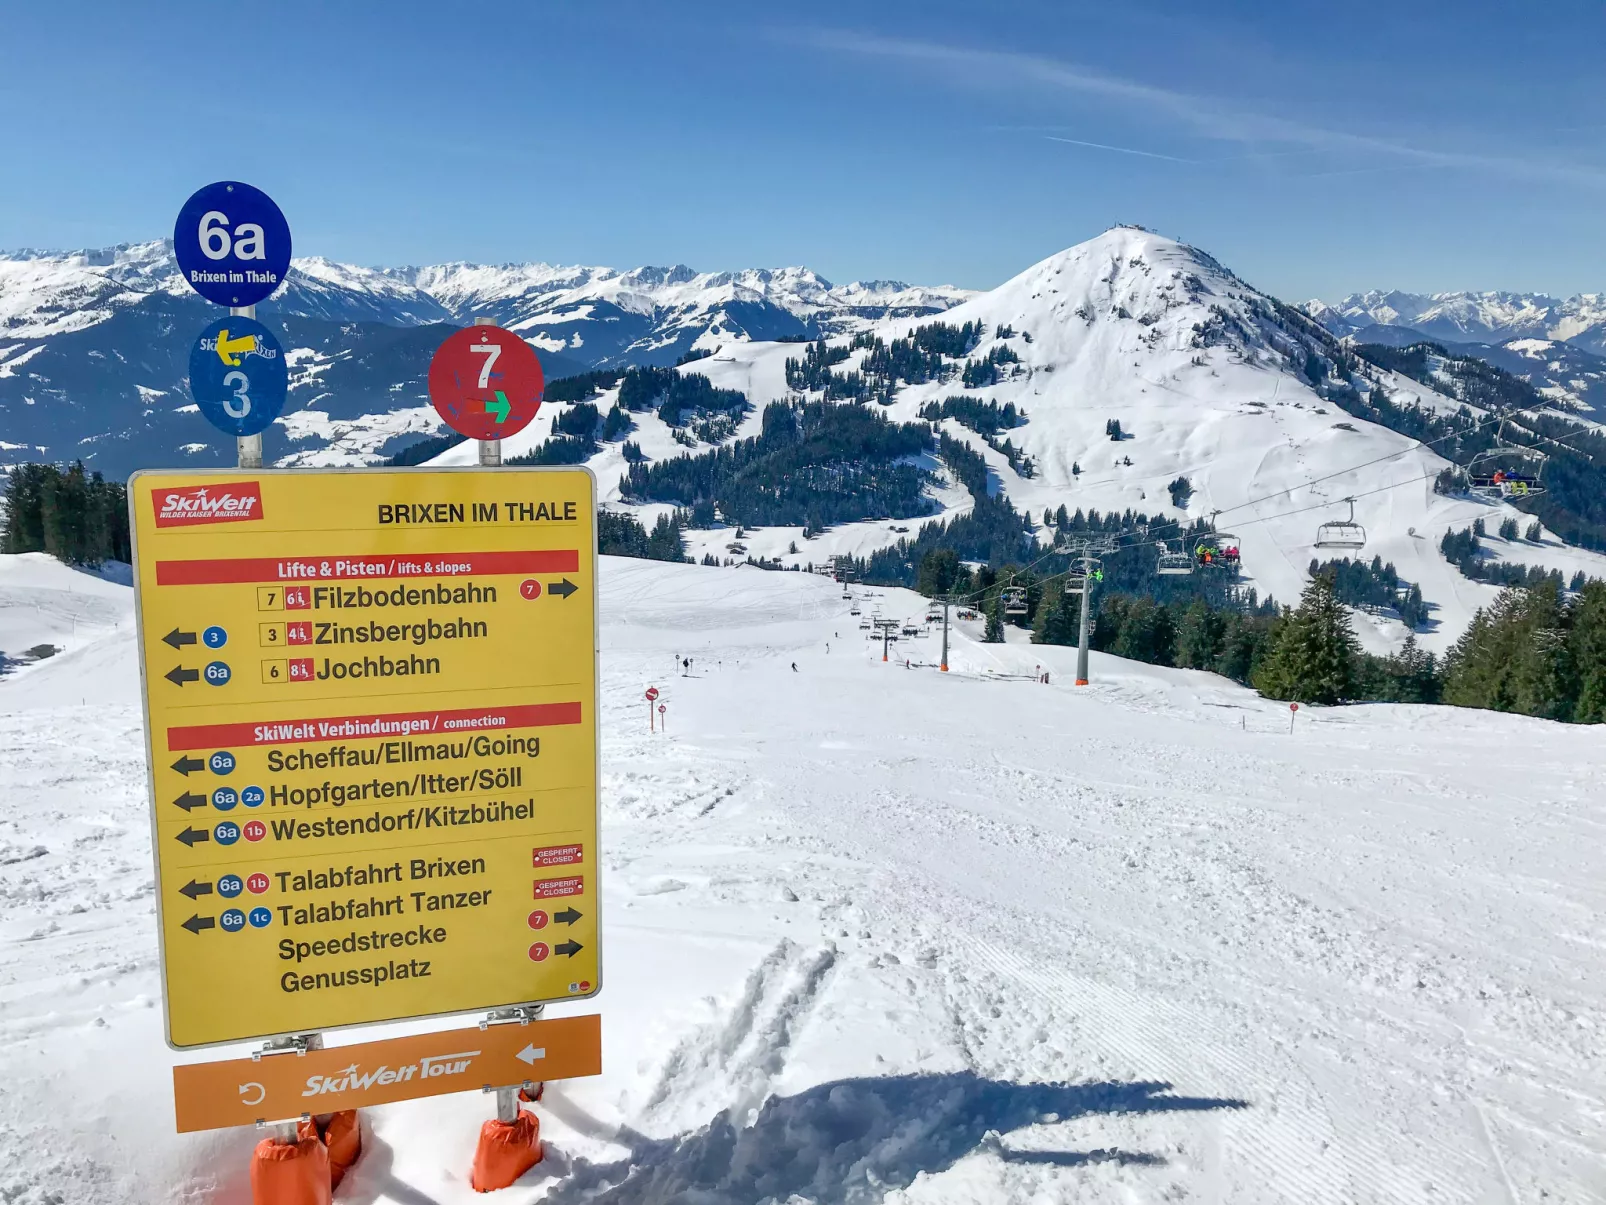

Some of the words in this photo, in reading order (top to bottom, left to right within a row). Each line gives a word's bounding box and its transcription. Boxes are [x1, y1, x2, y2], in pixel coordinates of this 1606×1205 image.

[198, 211, 265, 261] 6a
[191, 270, 227, 283] Brixen
[229, 270, 244, 283] im
[245, 269, 276, 283] Thale
[470, 344, 502, 388] 7
[222, 371, 251, 418] 3
[160, 511, 186, 519] WILDER
[161, 494, 256, 512] SkiWelt
[378, 503, 465, 524] BRIXEN
[472, 503, 498, 522] IM
[505, 502, 577, 521] THALE
[279, 561, 315, 578] Lifte
[320, 561, 332, 577] &
[336, 560, 385, 576] Pisten
[398, 562, 421, 574] lifts
[424, 562, 433, 573] &
[436, 560, 471, 574] slopes
[268, 593, 275, 606] 7
[287, 593, 295, 605] 6
[314, 584, 497, 609] Filzbodenbahn
[526, 585, 533, 594] 7
[210, 632, 218, 642] 3
[268, 628, 277, 642] 3
[288, 628, 297, 640] 4
[315, 617, 487, 646] Zinsbergbahn
[207, 665, 228, 680] 6a
[270, 665, 278, 678] 6
[291, 665, 299, 677] 8
[316, 655, 440, 680] Jochbahn
[254, 724, 316, 742] SkiWelt
[319, 717, 429, 736] Verbindungen
[444, 716, 506, 729] connection
[211, 756, 233, 770] 6a
[267, 735, 540, 773] Scheffau/Ellmau/Going
[214, 791, 236, 804] 6a
[245, 791, 261, 803] 2a
[270, 767, 522, 810] Hopfgarten/Itter/Söll
[216, 825, 238, 839] 6a
[247, 825, 263, 837] 1b
[271, 799, 534, 841] Westendorf/Kitzbühel
[538, 847, 578, 858] GESPERRT
[542, 855, 573, 864] CLOSED
[219, 878, 241, 892] 6a
[250, 877, 266, 890] 1b
[275, 863, 401, 894] Talabfahrt
[411, 856, 486, 880] Brixen
[539, 879, 578, 889] GESPERRT
[543, 887, 574, 896] CLOSED
[222, 912, 243, 926] 6a
[253, 912, 268, 924] 1c
[277, 898, 404, 928] Talabfahrt
[410, 888, 491, 913] Tanzer
[279, 924, 447, 963] Speedstrecke
[534, 915, 542, 925] 7
[281, 958, 431, 993] Genussplatz
[535, 947, 543, 957] 7
[302, 1065, 418, 1096] SkiWelt
[420, 1050, 481, 1079] Tour
